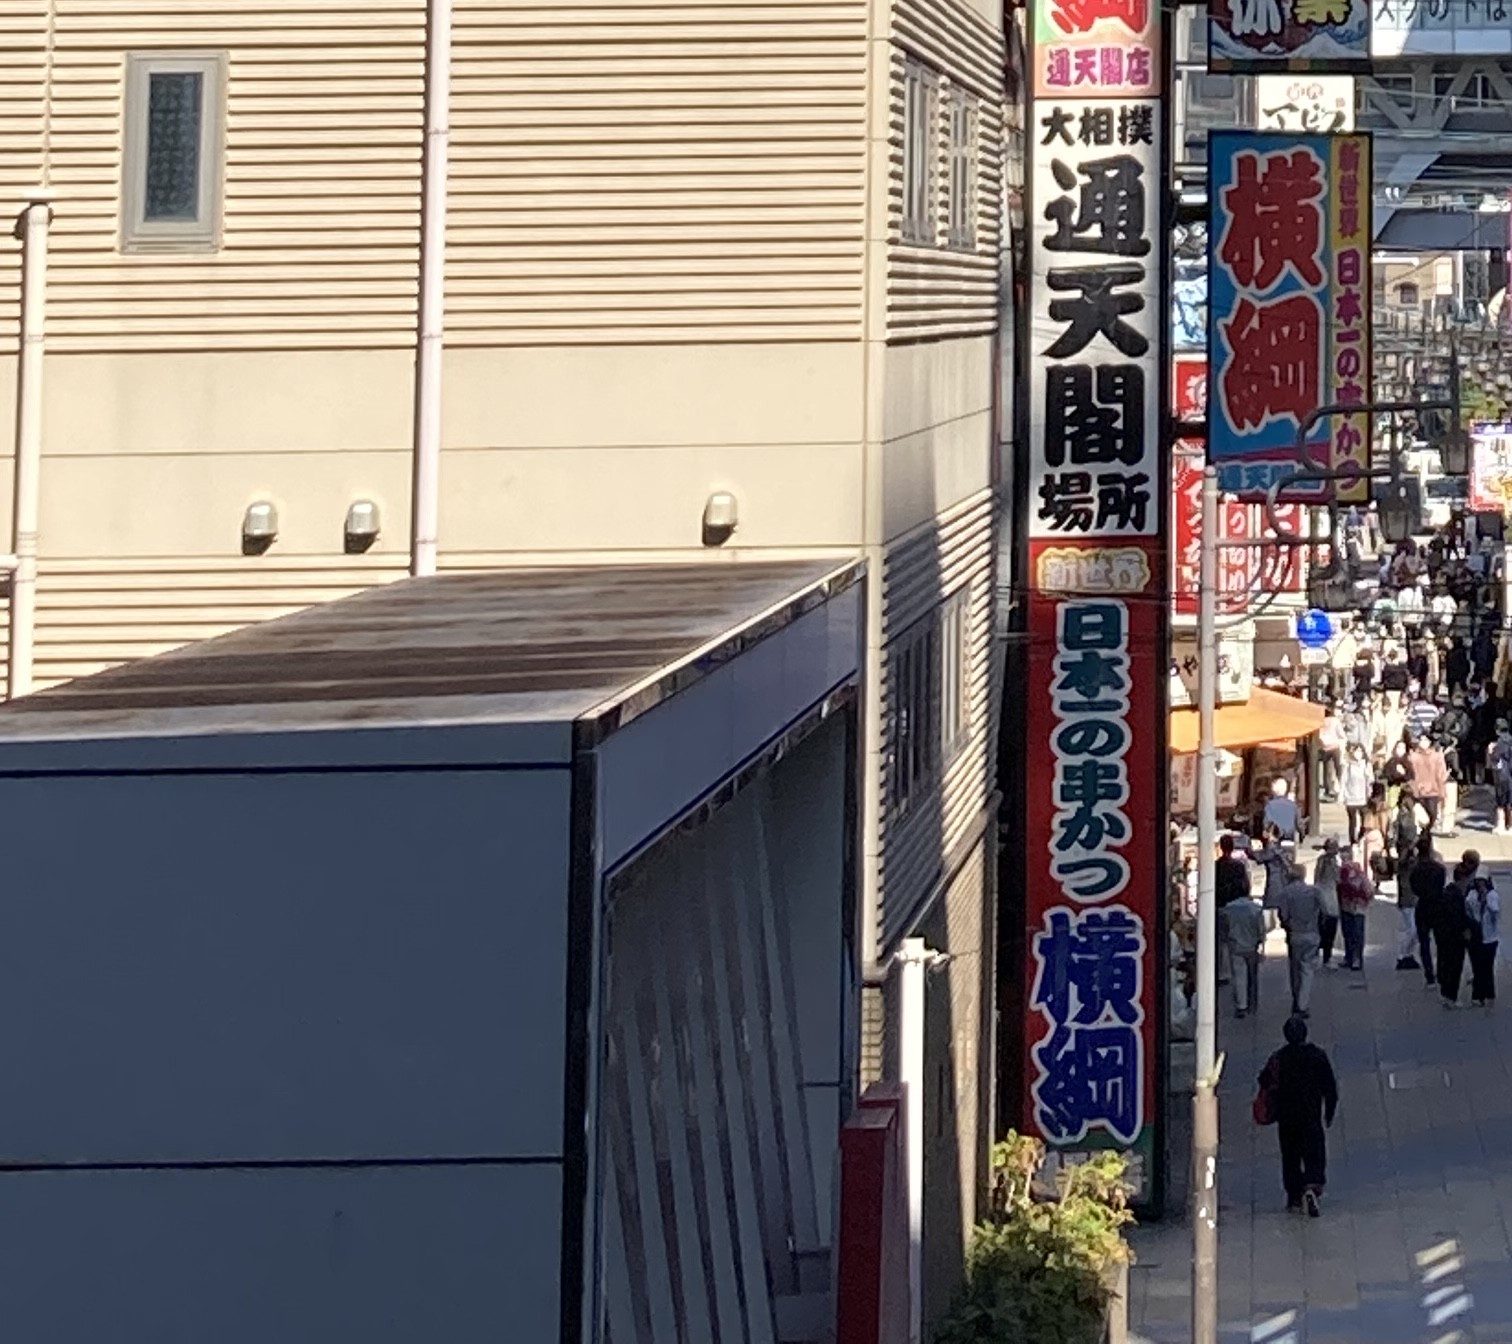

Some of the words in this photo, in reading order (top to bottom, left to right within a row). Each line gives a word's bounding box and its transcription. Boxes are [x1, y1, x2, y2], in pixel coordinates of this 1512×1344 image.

[1040, 105, 1153, 146] 大相撲
[1047, 46, 1151, 88] 通天閣店
[1041, 153, 1152, 467] 通天閣
[1220, 147, 1324, 434] 横綱
[1038, 472, 1151, 534] 場所
[1054, 601, 1127, 898] 日本一の串かつ
[1035, 909, 1142, 1140] 横綱
